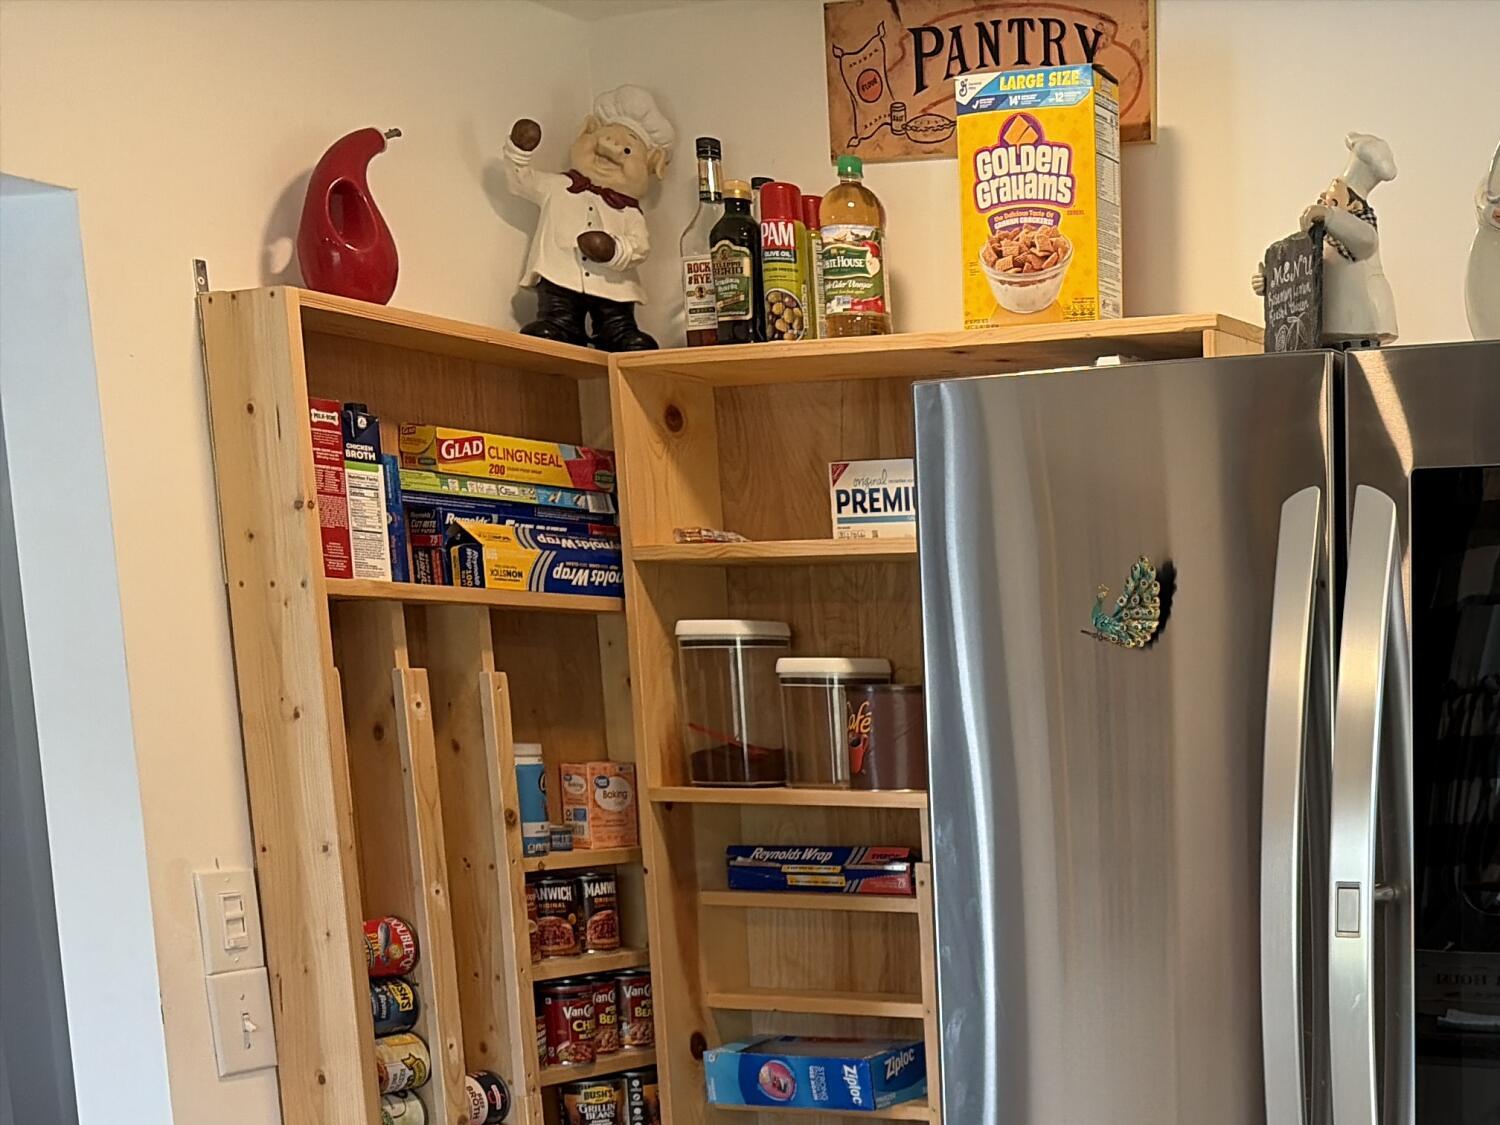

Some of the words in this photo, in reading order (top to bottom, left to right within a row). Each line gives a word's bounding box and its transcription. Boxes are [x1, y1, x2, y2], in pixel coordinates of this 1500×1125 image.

[907, 18, 1104, 96] PANTRY
[999, 73, 1045, 91] LARGE
[1048, 70, 1081, 87] SIZE
[760, 221, 795, 248] PAM
[686, 261, 711, 275] ROCK
[836, 255, 865, 268] HOUSE
[1270, 254, 1313, 289] MENU
[345, 442, 374, 452] CHICKEN
[345, 448, 377, 461] BROTH
[441, 439, 483, 460] GLAD
[488, 463, 506, 476] 200
[533, 452, 564, 468] SEAL
[852, 468, 888, 491] original
[552, 561, 590, 587] Wrap
[846, 700, 873, 736] afé
[602, 789, 629, 800] Baking
[750, 847, 801, 862] Reynolds
[801, 848, 834, 864] Wrap
[883, 1047, 916, 1081] Ziploc
[842, 1063, 863, 1106] Ziploc
[465, 1084, 481, 1121] BROTH
